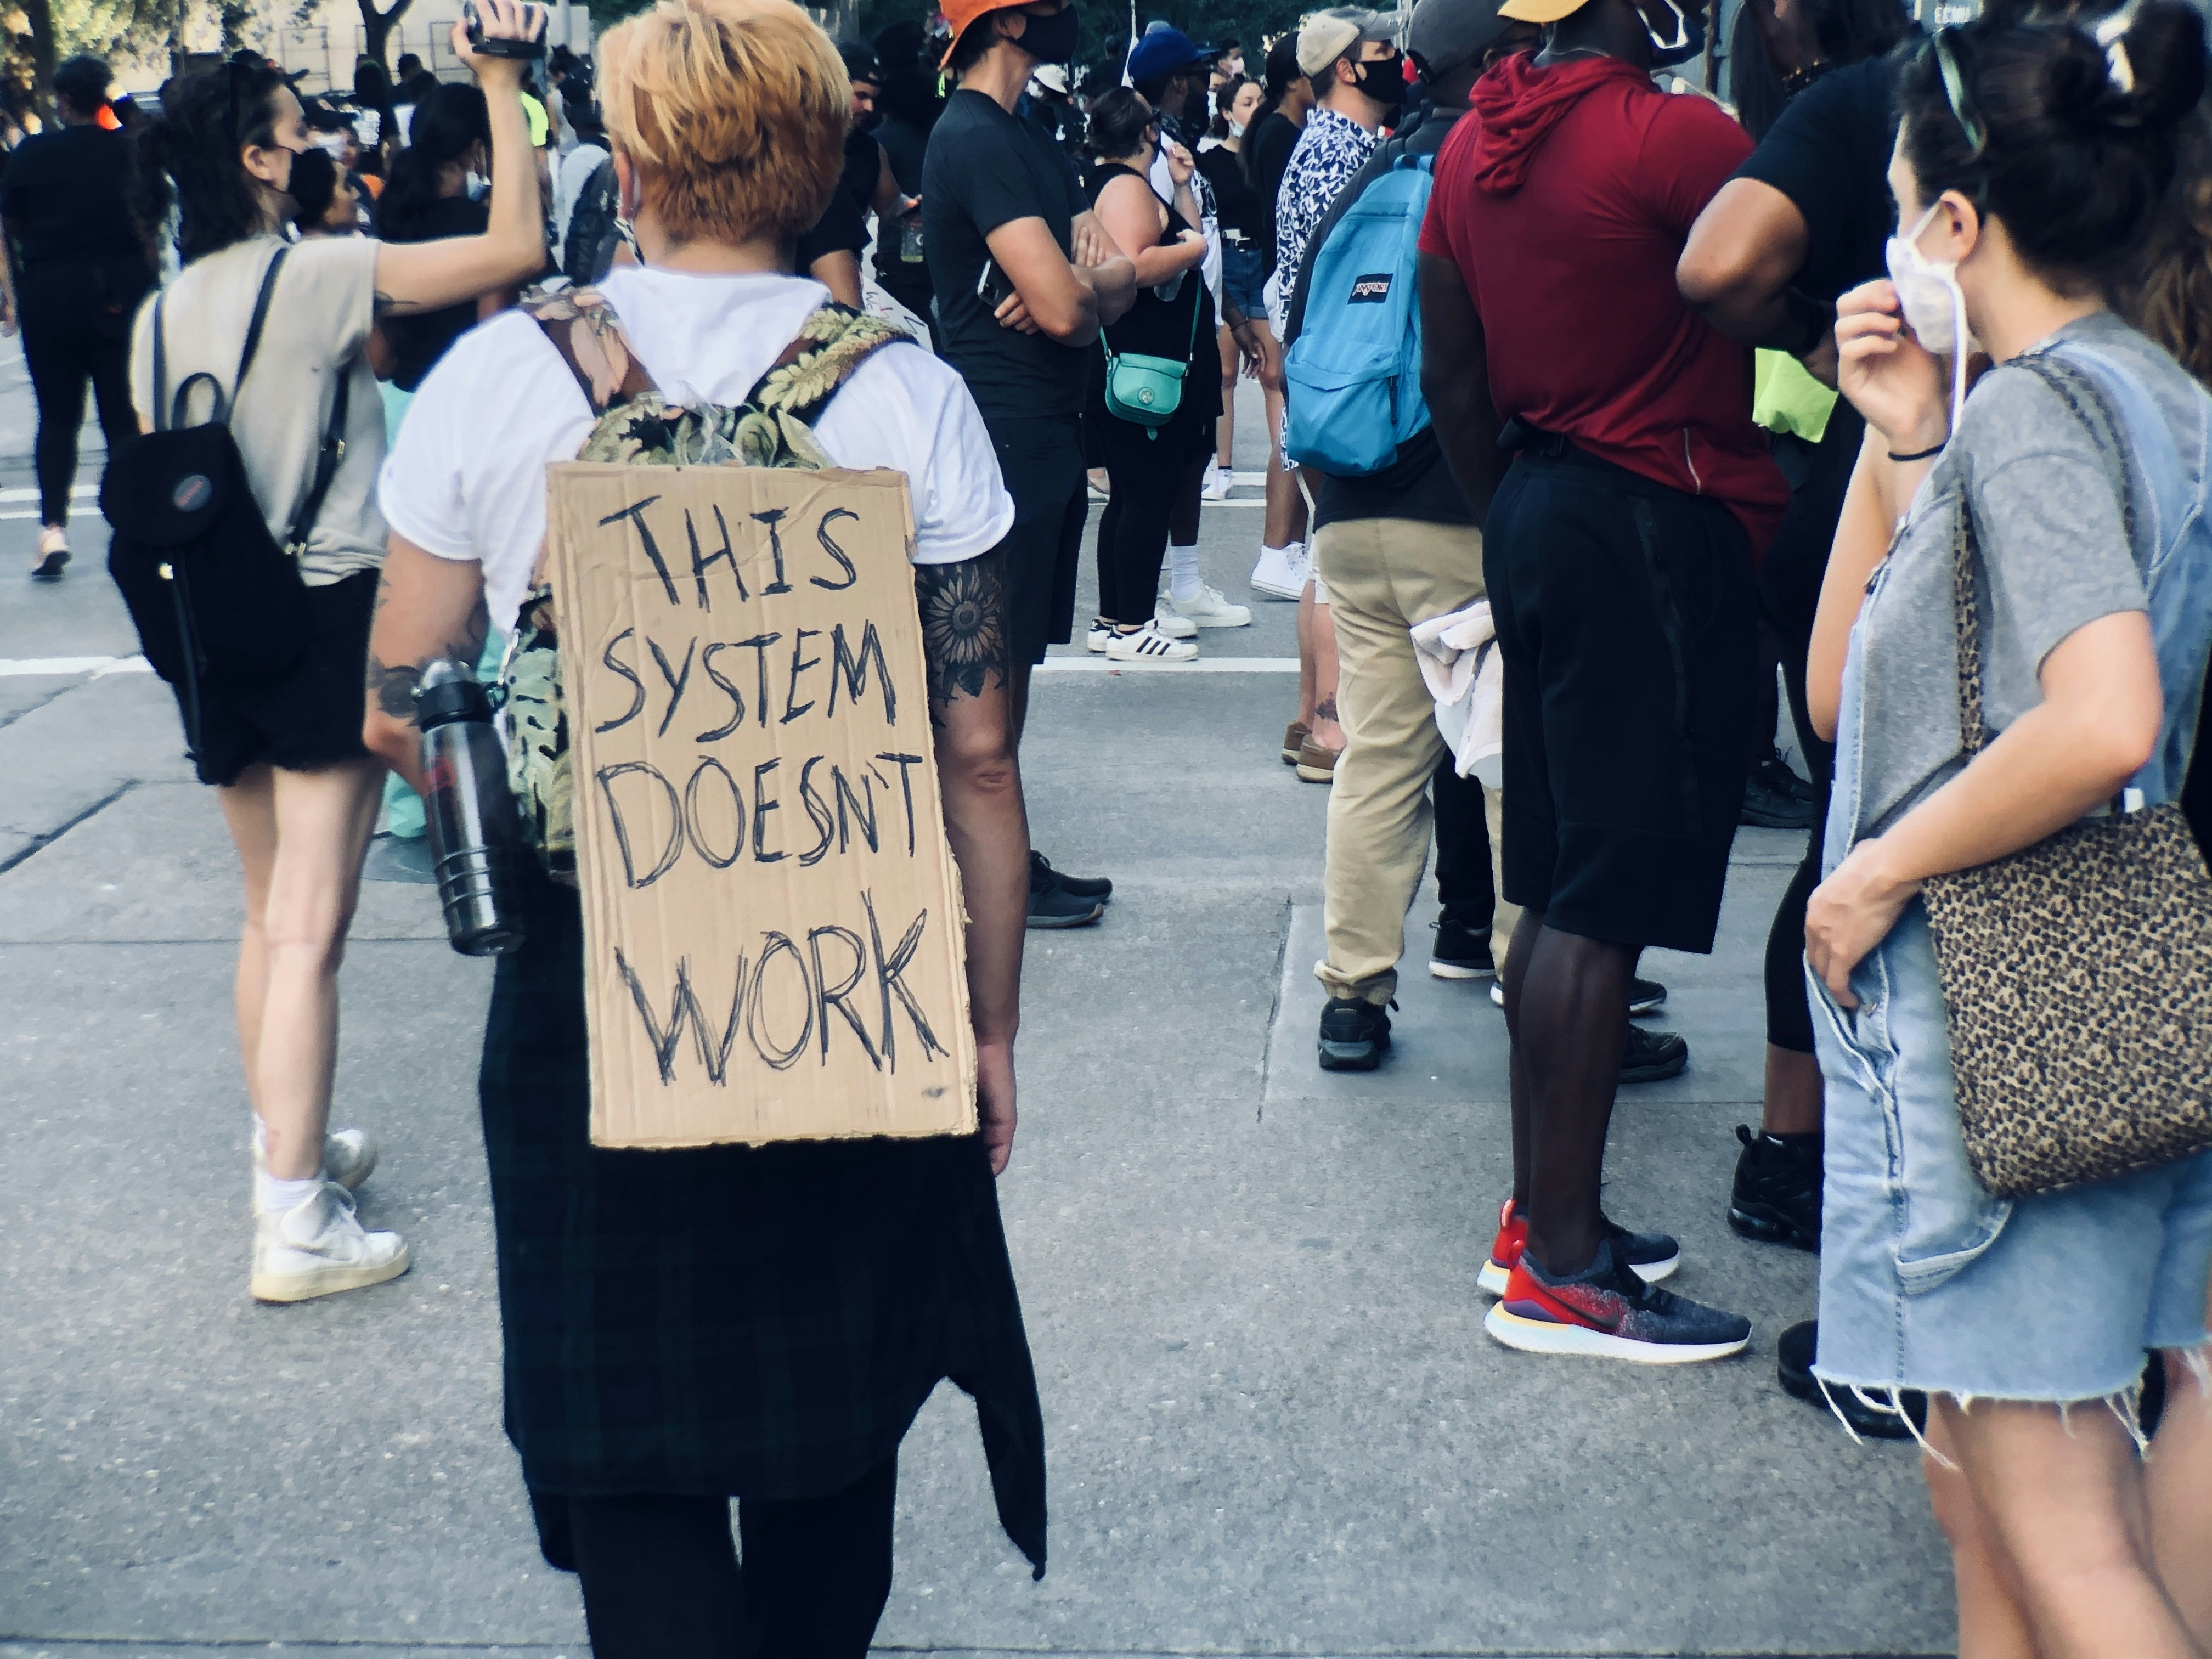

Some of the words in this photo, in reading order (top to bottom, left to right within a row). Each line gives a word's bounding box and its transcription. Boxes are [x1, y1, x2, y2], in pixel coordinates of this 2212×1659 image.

[599, 495, 859, 612] THIS
[595, 619, 896, 742] SYSTEM
[596, 753, 923, 888] DOESN'T
[614, 888, 950, 1087] WORK
